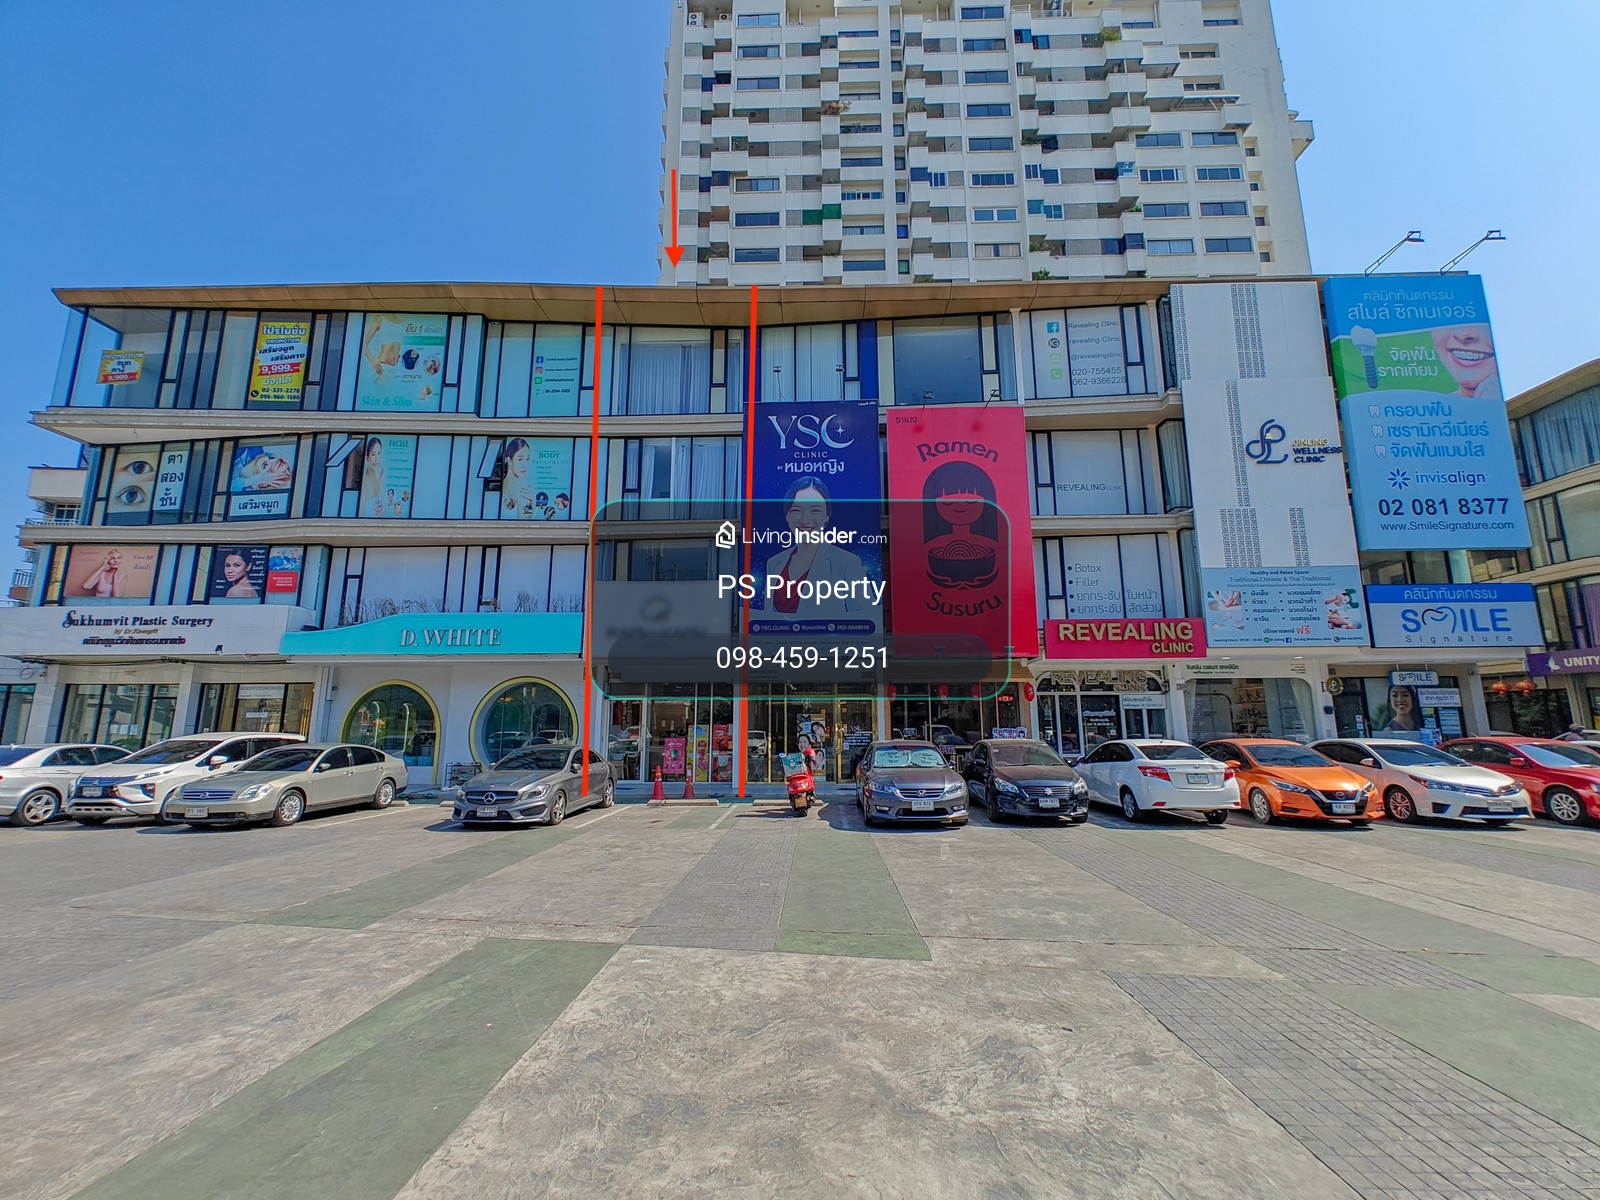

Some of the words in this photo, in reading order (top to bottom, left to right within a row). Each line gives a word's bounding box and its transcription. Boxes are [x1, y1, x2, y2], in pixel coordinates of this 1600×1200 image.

[1363, 290, 1454, 302] คลินิกทันตกรรม
[1347, 302, 1391, 321] สไมล์
[1395, 301, 1477, 320] ซิกเนเจอร์
[1068, 320, 1099, 330] Revealing
[1101, 319, 1120, 328] Clinic
[1069, 336, 1099, 345] revealing
[1101, 334, 1121, 343] Clinic
[1389, 345, 1437, 362] จัดฟัน
[1071, 366, 1122, 376] 020-755455
[1378, 363, 1439, 378] รากเทียม
[1384, 400, 1453, 418] ครอบฟัน
[1387, 420, 1489, 439] เซรามิกวีเนียร์
[916, 440, 1000, 463] Ramen
[1293, 446, 1343, 455] WELLNESS
[1389, 440, 1486, 459] จัดฟันแบบใส
[168, 453, 183, 465] ตา
[1293, 455, 1325, 464] CLINIC
[784, 458, 845, 475] หมอหญิง
[160, 471, 184, 483] สอง
[1414, 469, 1487, 488] invisalign
[1057, 483, 1106, 492] REVEALING
[159, 487, 177, 508] ชั้น
[238, 498, 279, 516] เสริมจมูก
[1378, 499, 1404, 516] 02
[1412, 499, 1451, 516] 081
[1459, 498, 1509, 515] 8377
[1380, 520, 1515, 533] www.SmileSignature.com
[1074, 563, 1102, 574] Botox
[1075, 577, 1100, 587] Filler
[1077, 589, 1121, 601] ยกกระชับ
[1126, 588, 1159, 601] ใบหน้า
[1404, 587, 1497, 600] คลินิกทันตกรรม
[925, 591, 1004, 617] Susuru
[1077, 602, 1123, 614] ยกกระชับ
[1128, 602, 1163, 614] สัดส่วน
[62, 610, 129, 628] Sukhumvit
[131, 616, 167, 626] Plastic
[172, 616, 214, 628] Surgery
[1059, 622, 1193, 641] REVEALING
[1295, 624, 1311, 635] ฟรี
[400, 629, 419, 647] D.
[423, 628, 502, 647] WHITE
[1405, 634, 1514, 645] Signature
[1152, 642, 1195, 653] CLINIC
[1563, 656, 1600, 667] UNITY
[1051, 670, 1148, 685] REVEALING
[1113, 684, 1148, 692] CLINIC
